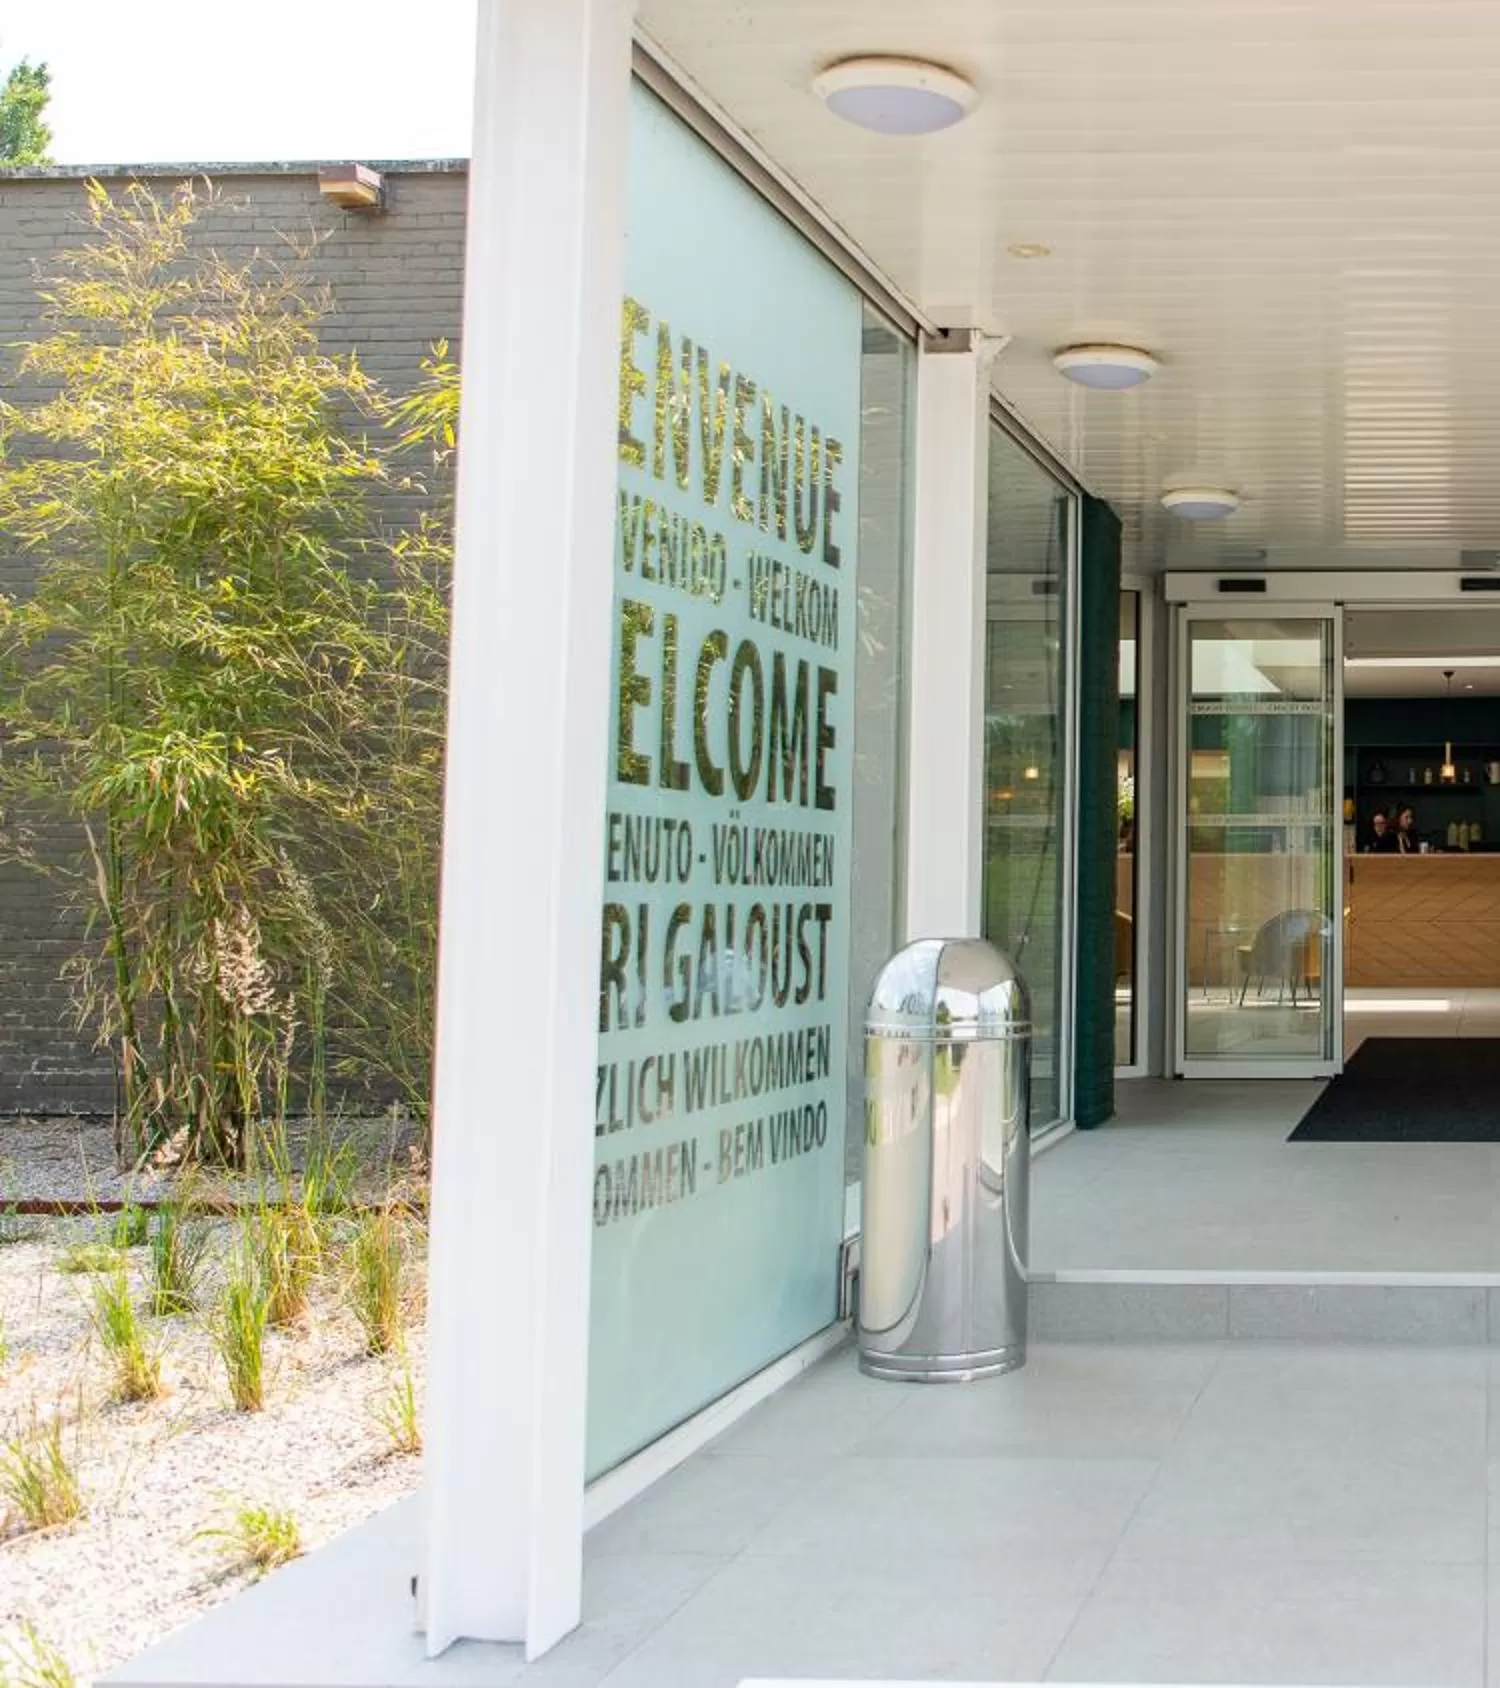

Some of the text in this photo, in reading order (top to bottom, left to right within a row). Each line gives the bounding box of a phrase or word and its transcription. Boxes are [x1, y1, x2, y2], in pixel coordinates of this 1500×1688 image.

[617, 295, 843, 569] ENVENUE
[619, 488, 726, 606] VENIDO
[749, 550, 839, 651] WELKOM
[616, 597, 839, 811] ELCOME
[607, 812, 693, 884] ENUTO
[712, 810, 835, 887] VÖLKOMMEN
[597, 902, 832, 1033] RI GALOUST
[683, 1024, 830, 1113] WILKOMMEN
[717, 1118, 763, 1184] BEM
[769, 1100, 828, 1165] VINDO
